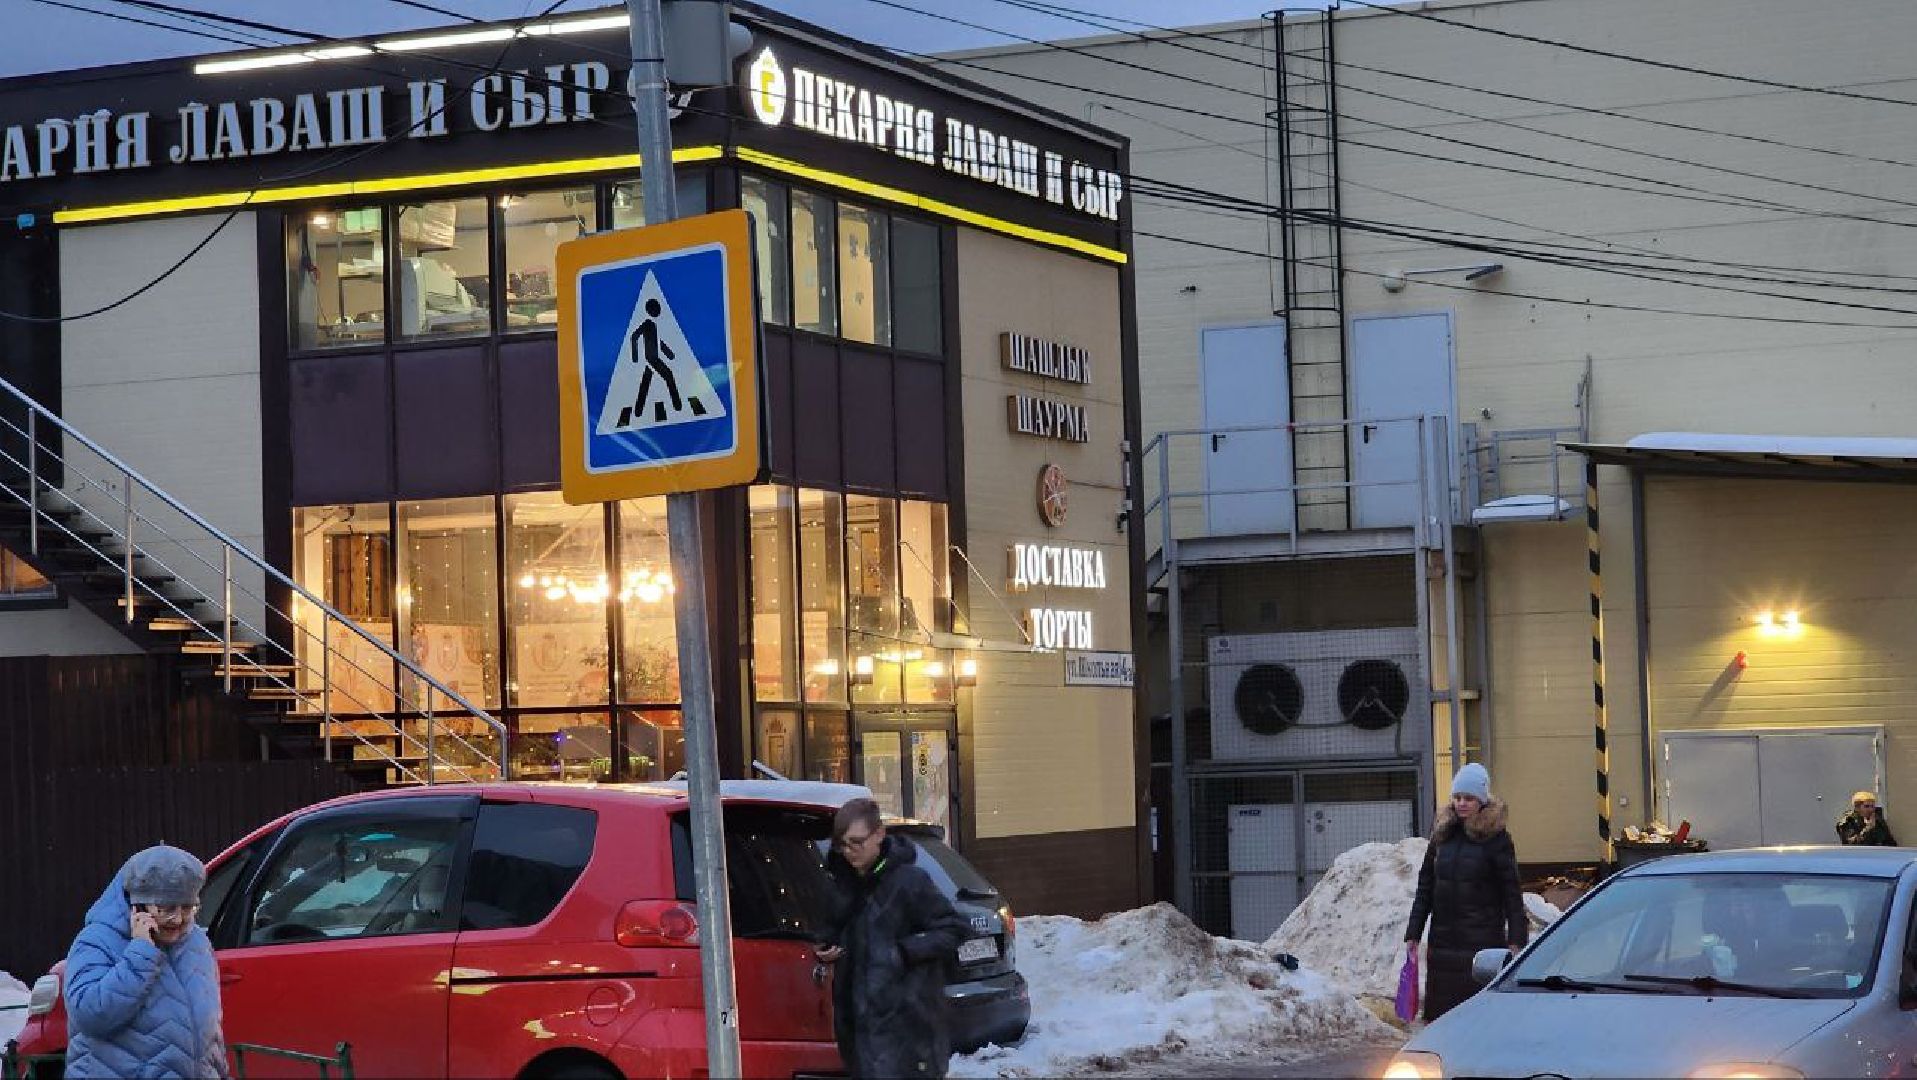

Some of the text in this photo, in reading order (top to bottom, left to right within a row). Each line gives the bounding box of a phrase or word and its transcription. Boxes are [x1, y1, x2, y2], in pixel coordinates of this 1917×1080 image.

[169, 85, 387, 164] ЛАВАШ
[407, 79, 449, 138] И
[471, 61, 610, 131] СЫР
[792, 67, 1122, 221] ПЕКАРНЯ ЛАВАШ И СЫР
[1009, 332, 1092, 384] ШАШЛЫК
[1015, 394, 1091, 443] ШАУРМА
[1014, 544, 1106, 591] ДОСТАВКА
[1030, 608, 1092, 649] ТОРТЫ
